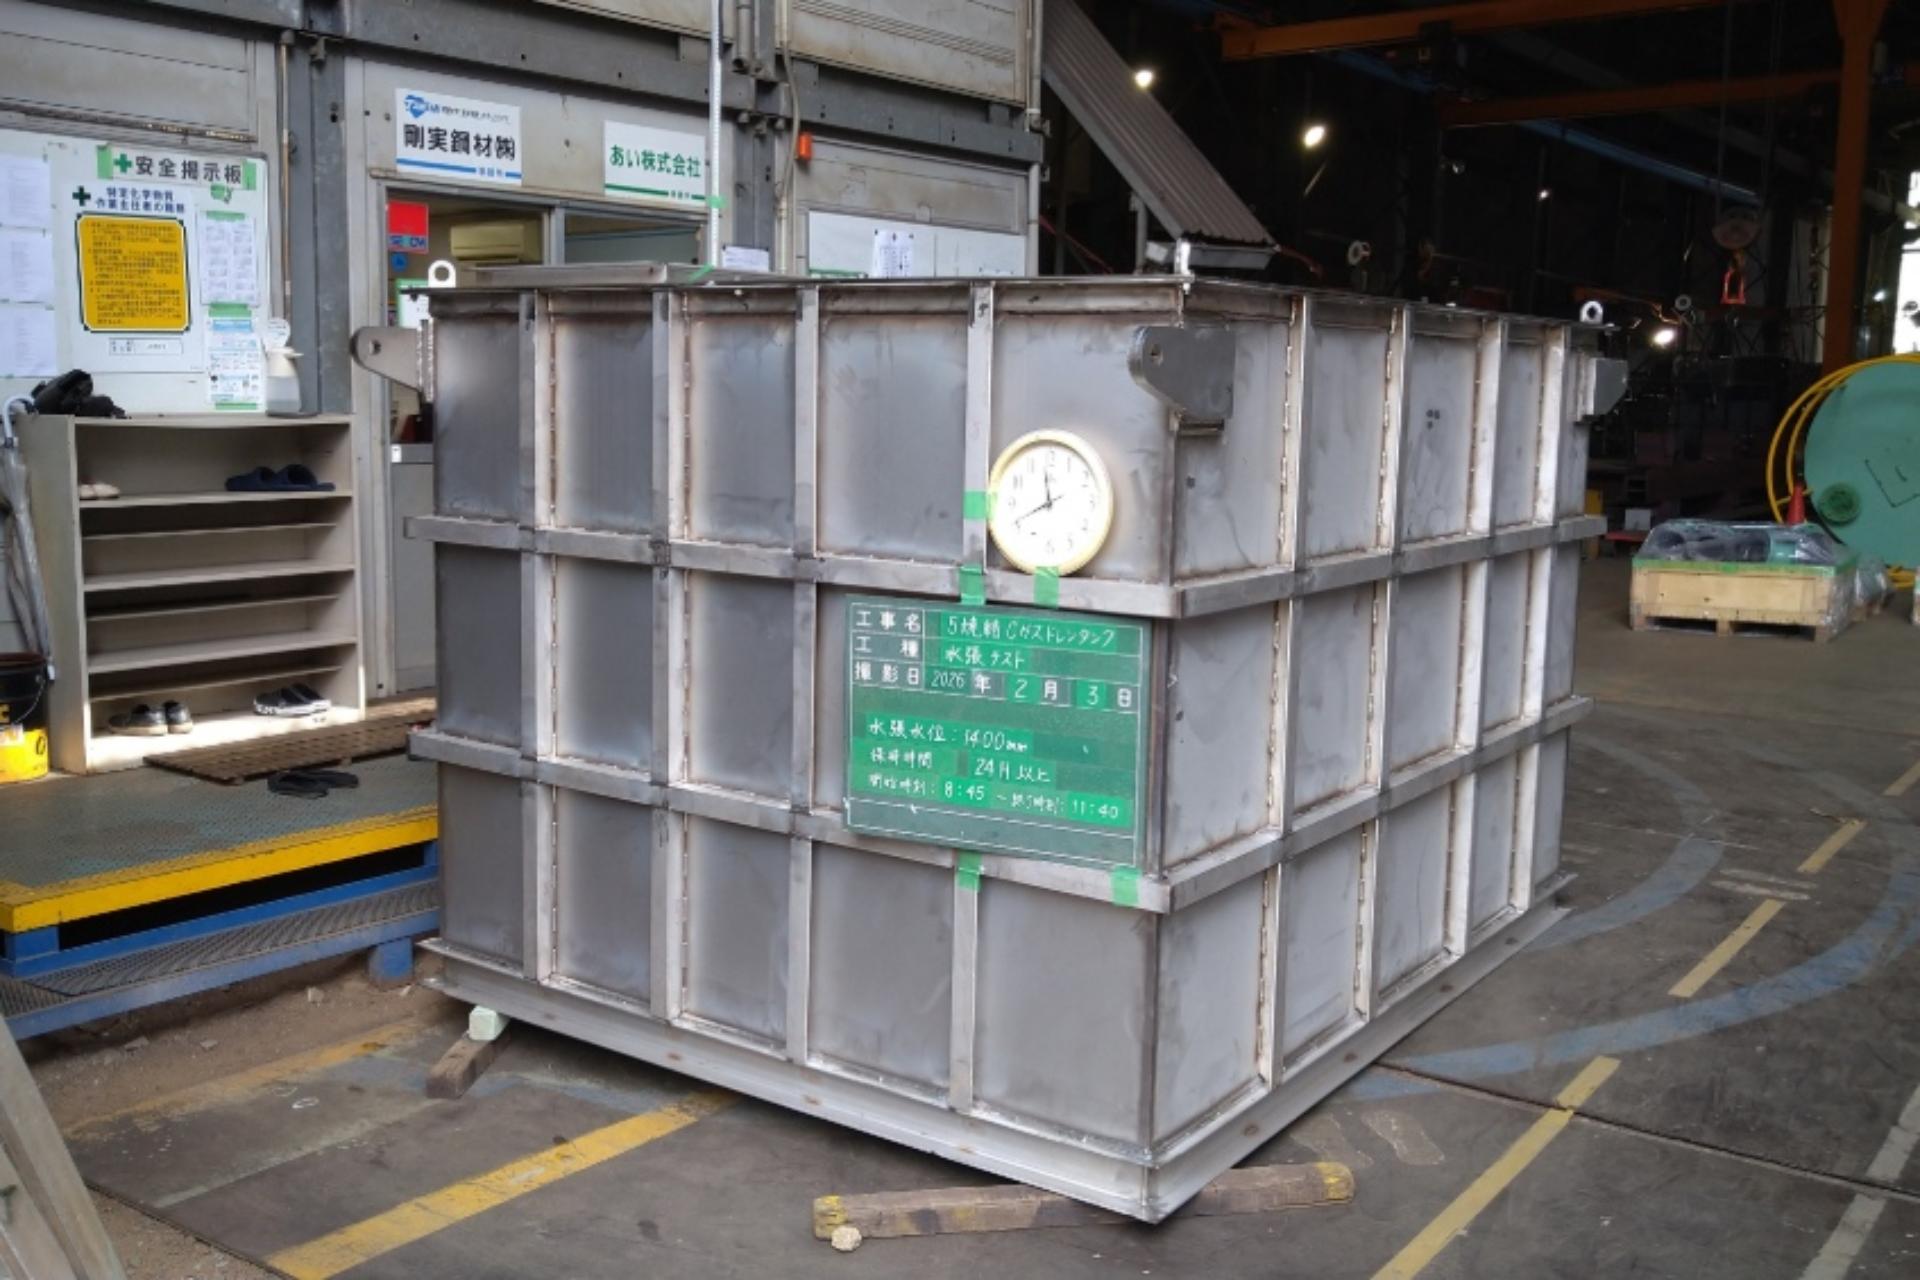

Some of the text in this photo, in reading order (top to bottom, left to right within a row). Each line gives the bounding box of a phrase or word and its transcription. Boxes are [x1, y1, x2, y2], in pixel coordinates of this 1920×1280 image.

[135, 155, 242, 184] 安全掲示板
[609, 143, 702, 178] あい株式会社
[855, 610, 921, 633] 工事名
